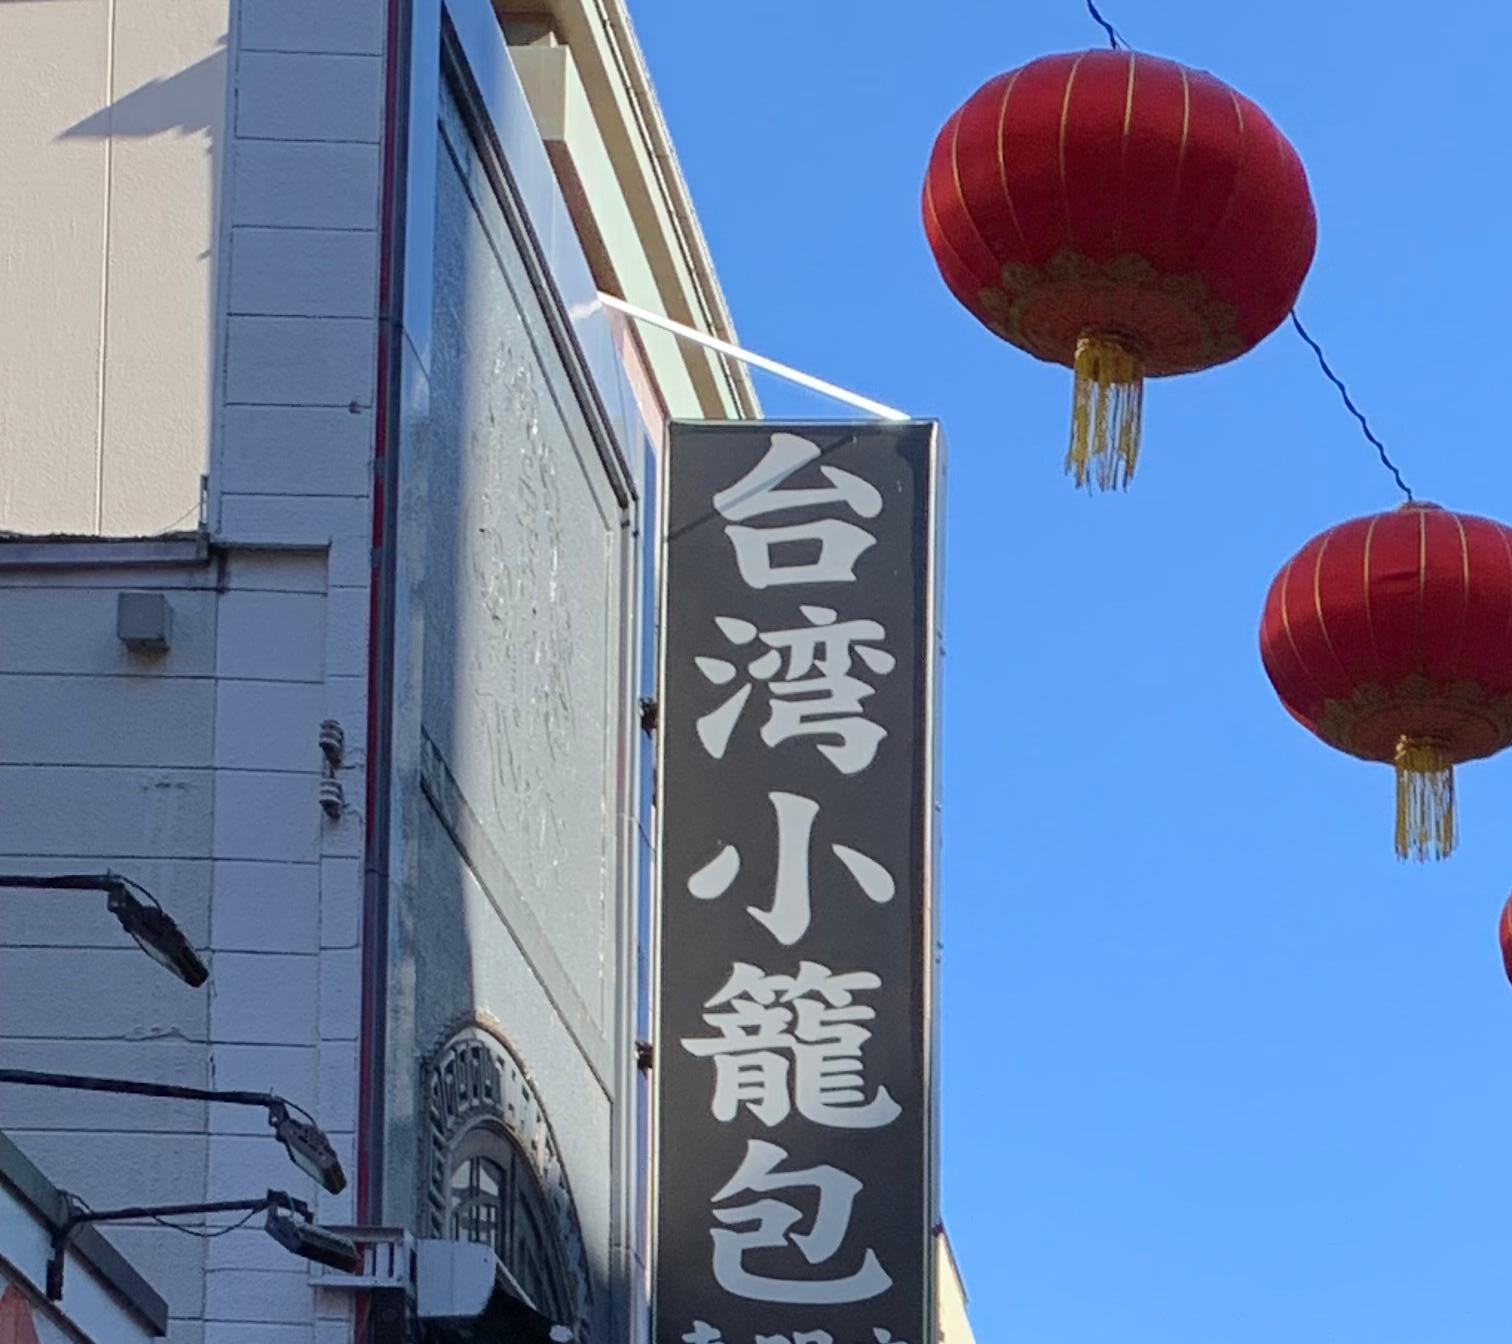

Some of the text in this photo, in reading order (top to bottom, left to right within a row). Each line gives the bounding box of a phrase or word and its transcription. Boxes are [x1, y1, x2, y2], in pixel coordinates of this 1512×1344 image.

[680, 432, 904, 1305] 台湾小籠包
